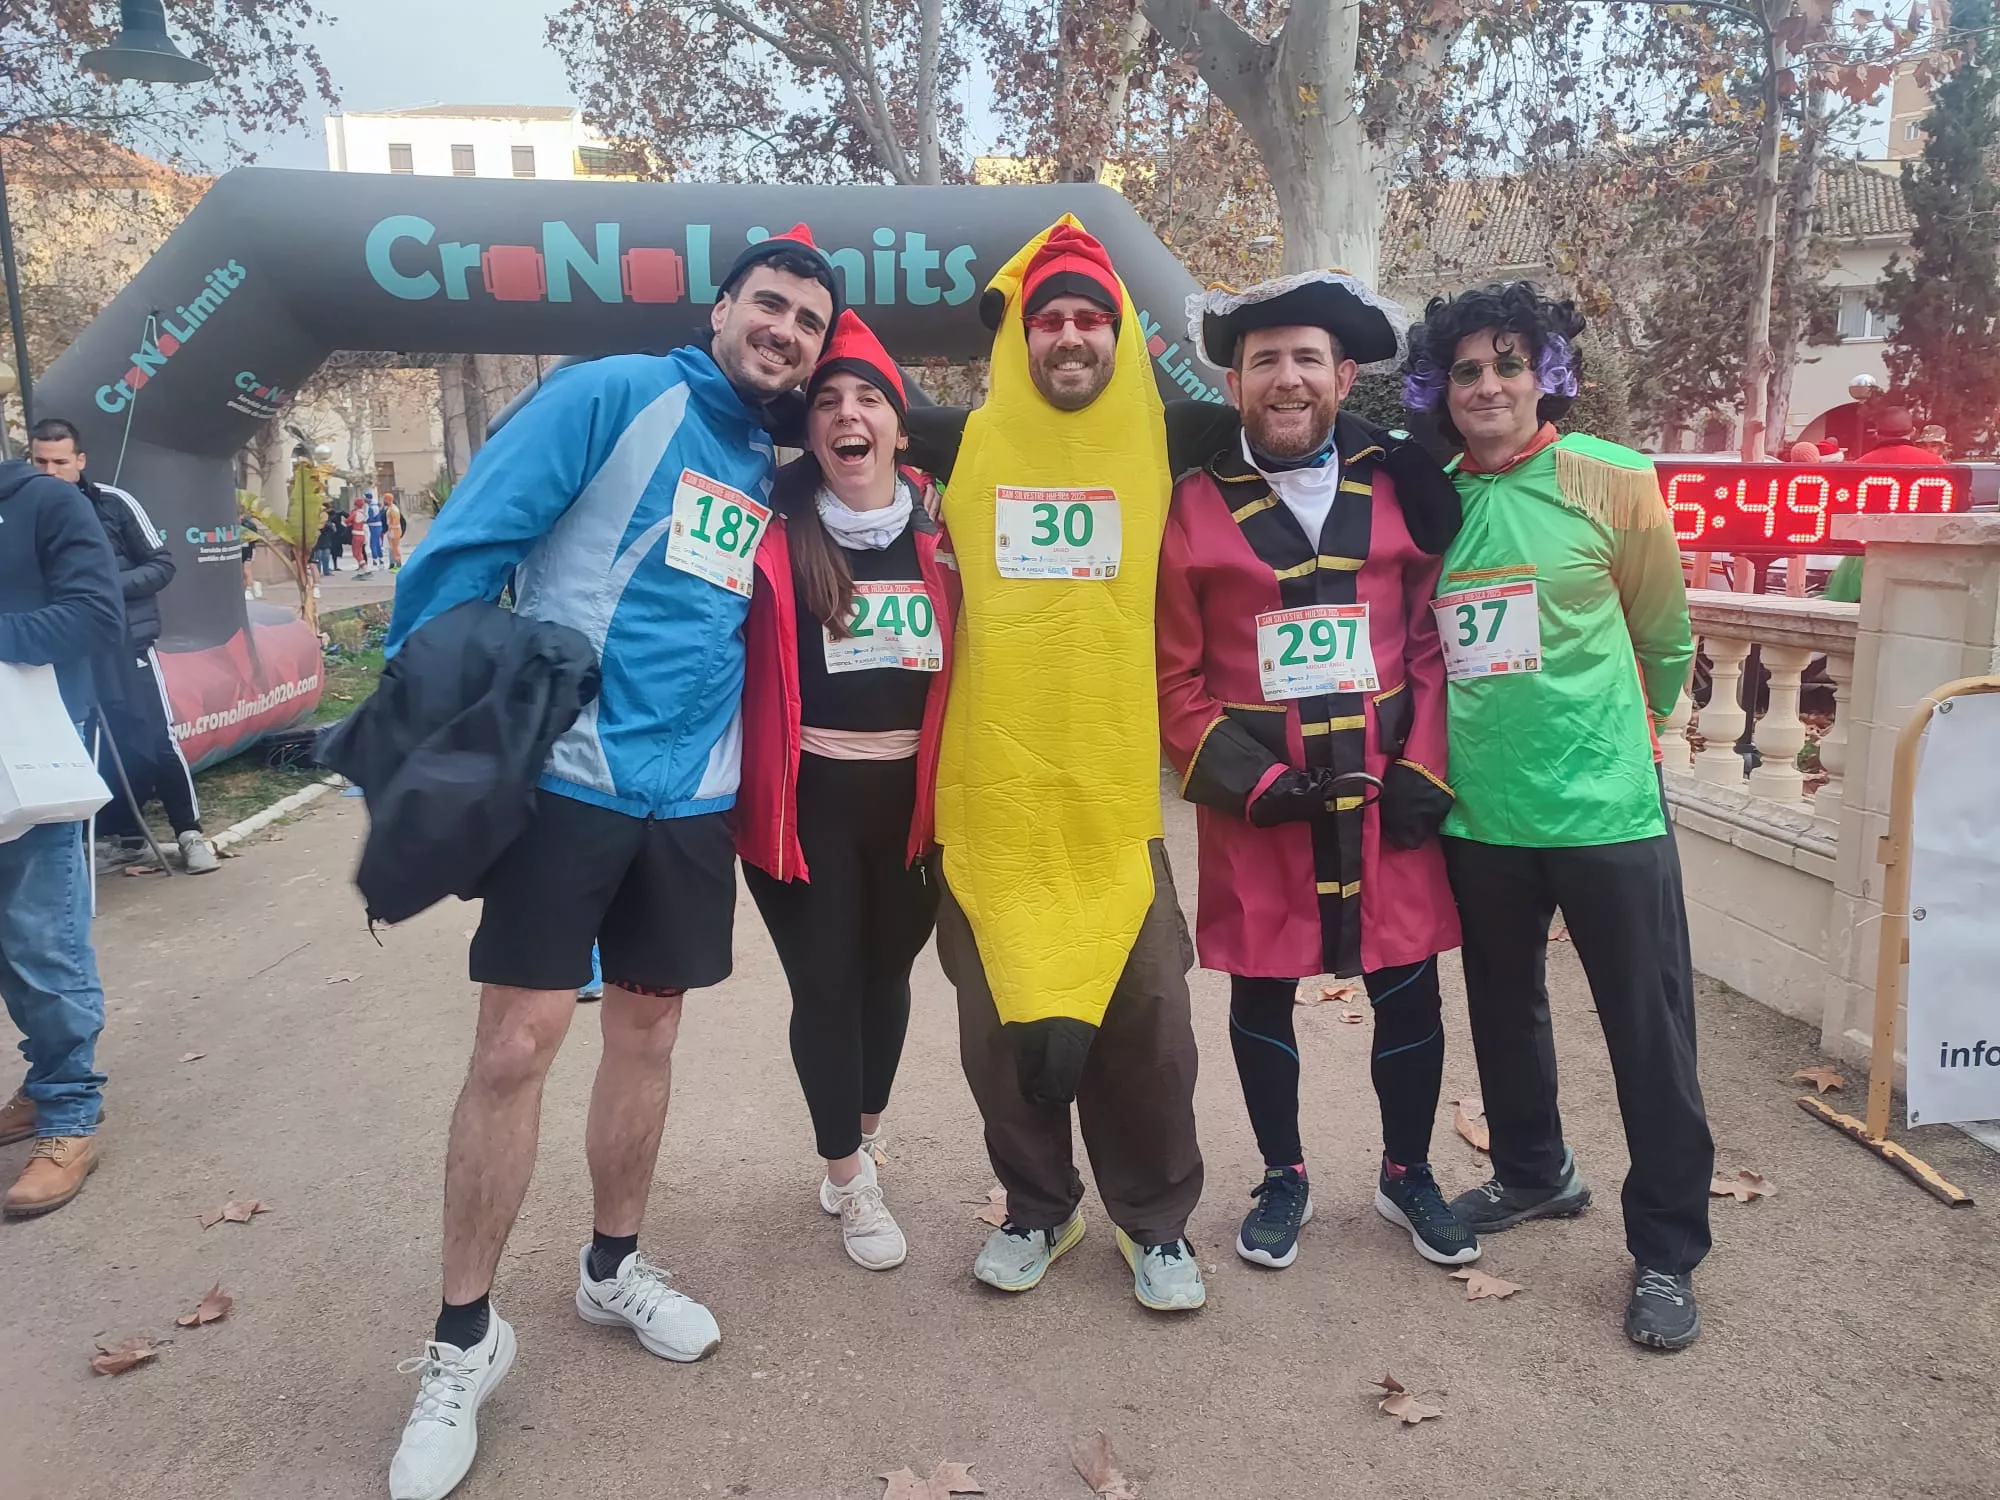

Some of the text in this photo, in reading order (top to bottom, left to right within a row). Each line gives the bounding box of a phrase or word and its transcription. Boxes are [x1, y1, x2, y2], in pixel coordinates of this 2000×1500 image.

[365, 214, 977, 307] CroNoLmits
[690, 495, 760, 558] 187
[1031, 503, 1094, 547] 30
[850, 595, 932, 637] 240
[1456, 599, 1508, 647] 37
[1277, 619, 1358, 666] 297
[174, 674, 318, 741] w.cronolimits2020.com
[1941, 1040, 2000, 1068] info
